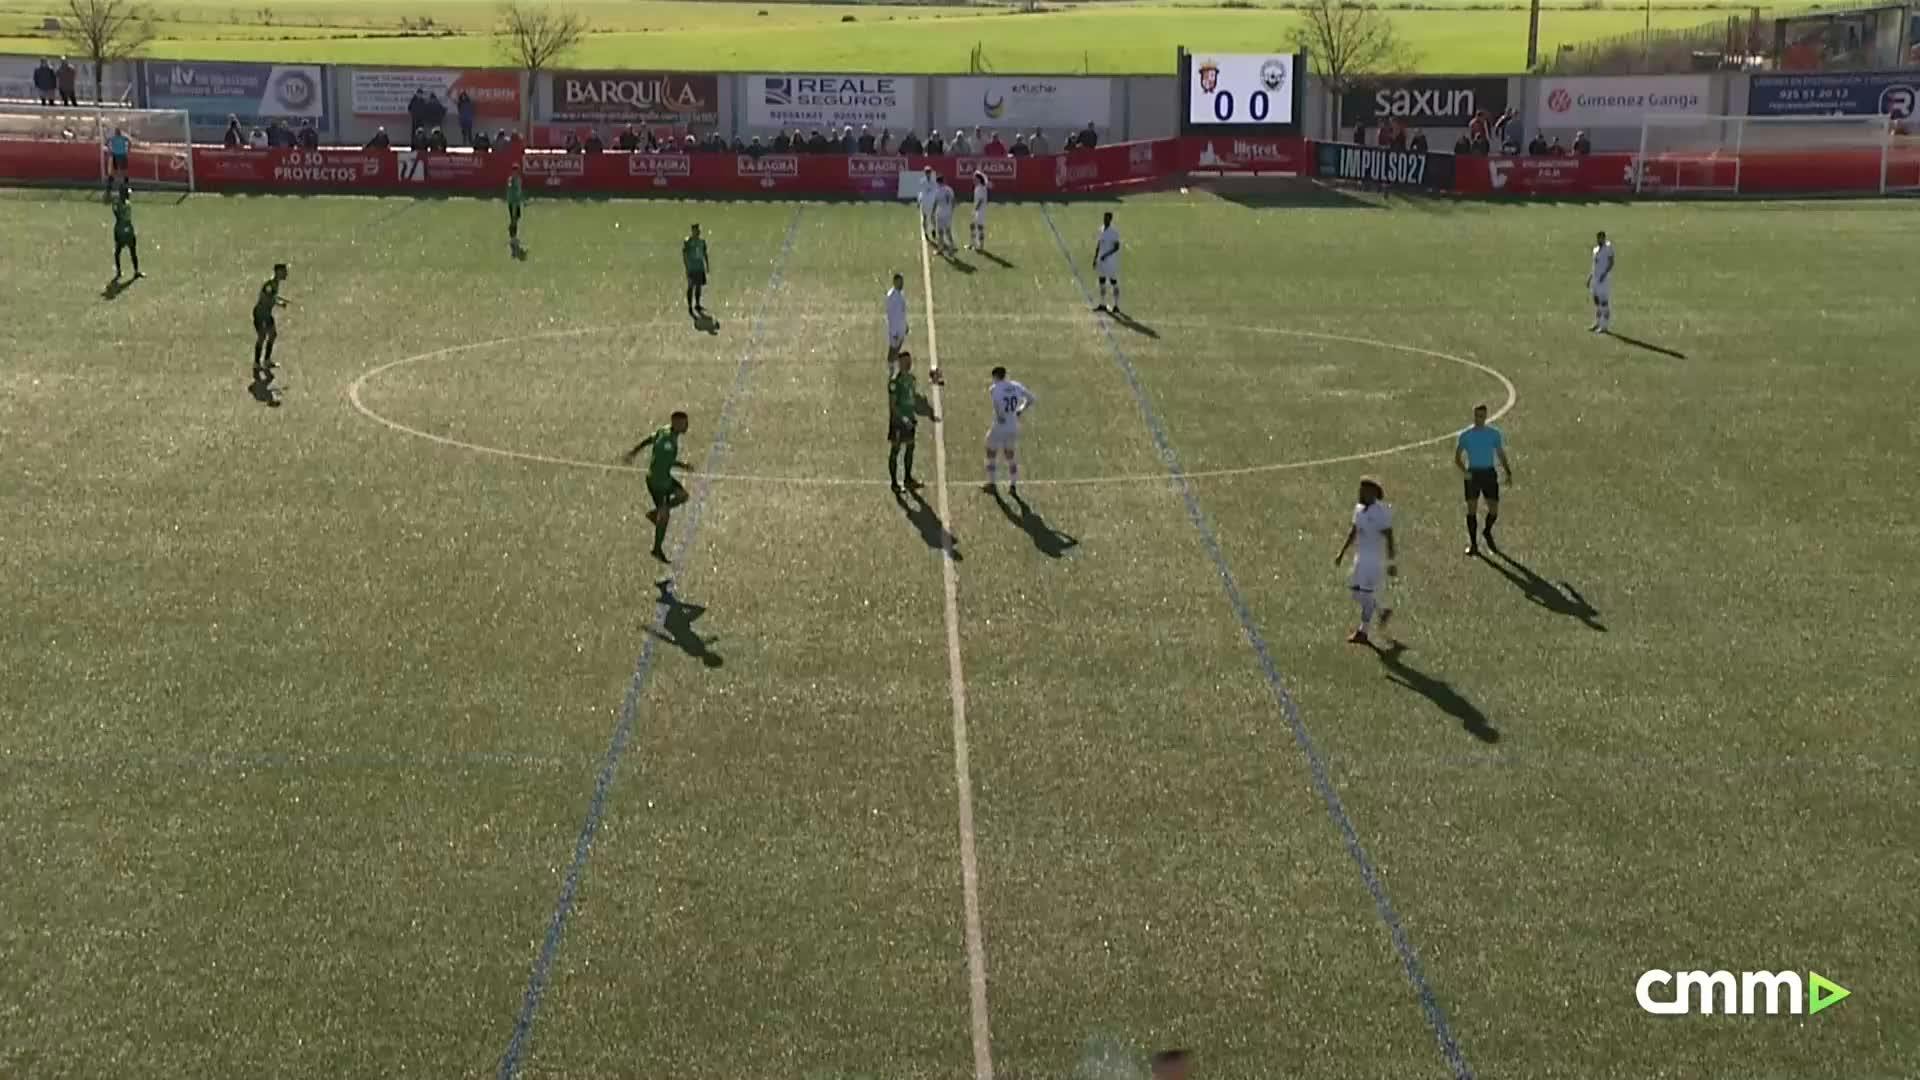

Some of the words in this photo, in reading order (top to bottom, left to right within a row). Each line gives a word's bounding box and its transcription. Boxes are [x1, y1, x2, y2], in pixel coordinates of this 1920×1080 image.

[798, 79, 896, 94] REALE
[798, 95, 897, 107] SEGUROS
[1215, 90, 1234, 121] 0
[1249, 90, 1269, 121] 0
[1374, 87, 1475, 117] saxun
[1649, 92, 1698, 109] Ganga
[274, 167, 357, 182] PROYECTOS
[1003, 395, 1018, 413] 20
